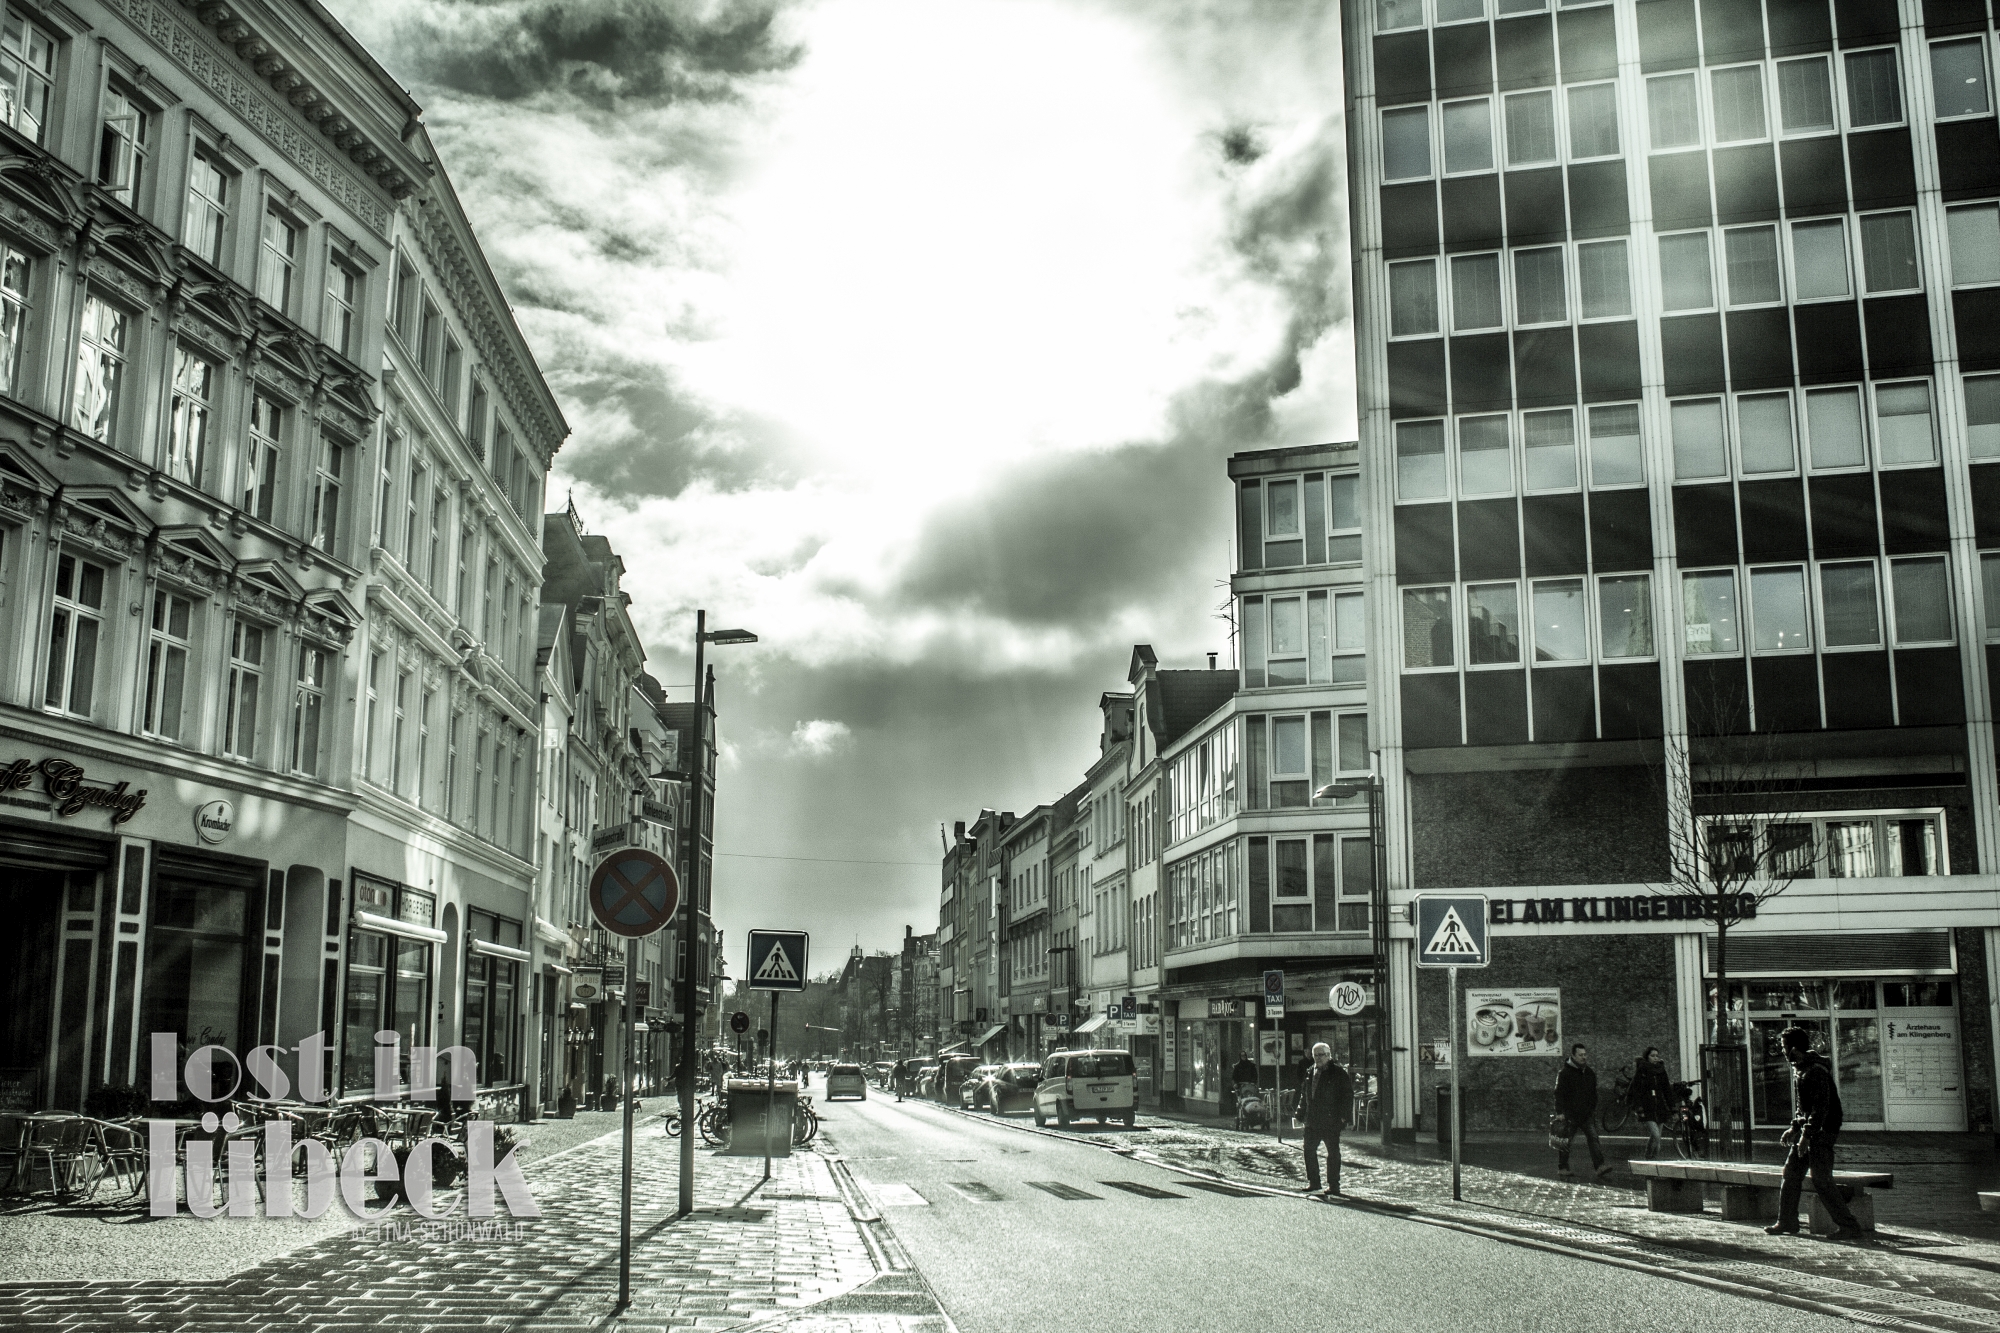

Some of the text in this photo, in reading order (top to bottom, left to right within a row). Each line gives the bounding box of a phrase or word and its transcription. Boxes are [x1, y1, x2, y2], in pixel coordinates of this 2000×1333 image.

[1523, 897, 1565, 924] AM
[1572, 893, 1757, 922] KLINGENBERG
[1266, 994, 1283, 1004] TAXI
[1110, 1005, 1119, 1018] P
[1059, 1014, 1067, 1024] P
[1909, 1031, 1951, 1039] Klingenberg
